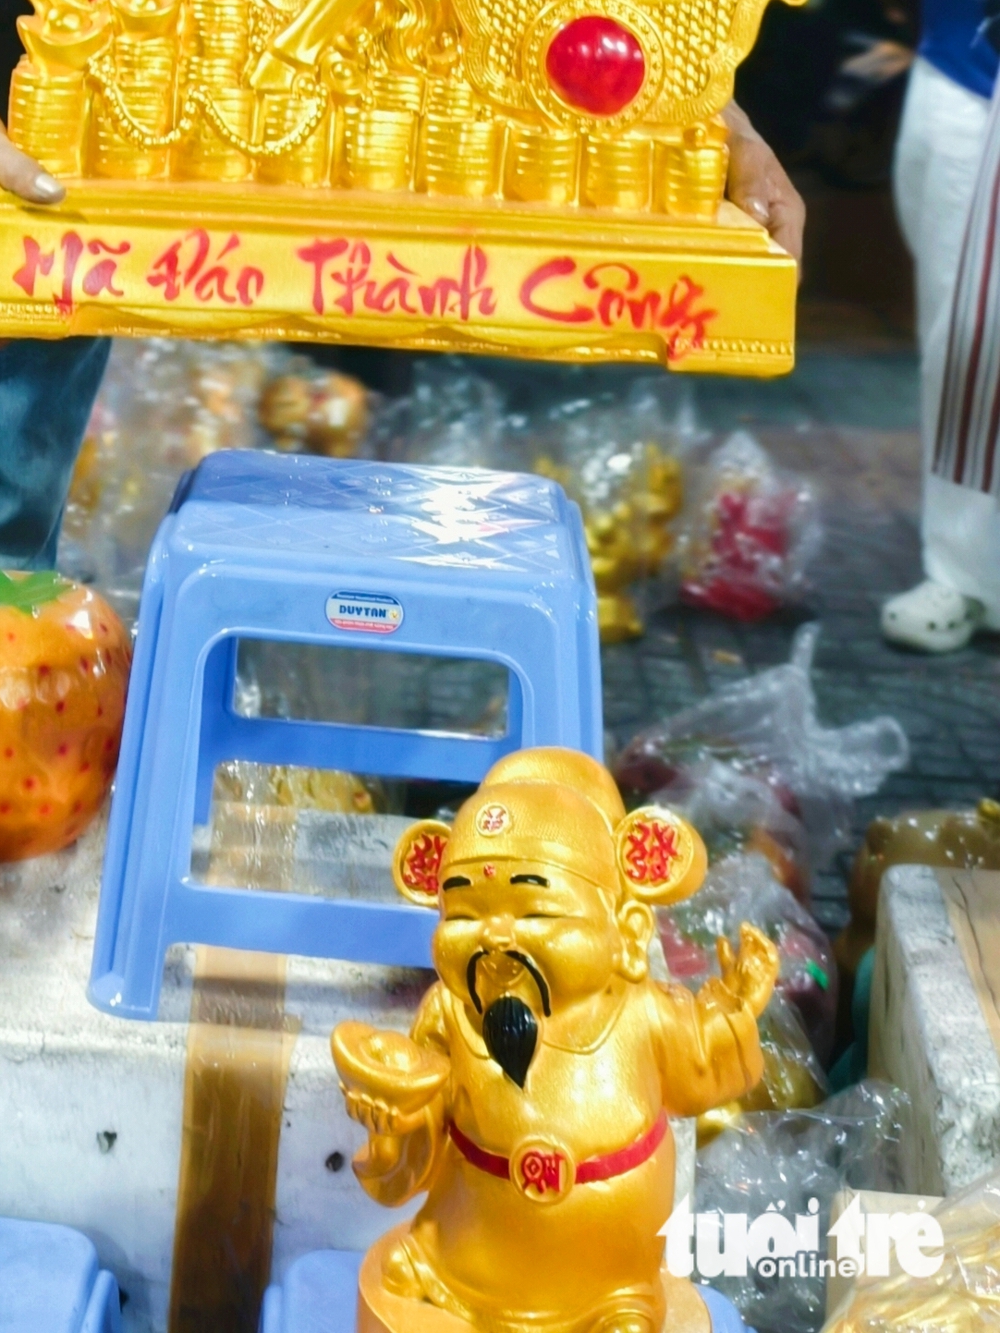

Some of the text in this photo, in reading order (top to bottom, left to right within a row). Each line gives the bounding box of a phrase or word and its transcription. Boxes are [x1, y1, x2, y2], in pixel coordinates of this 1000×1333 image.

[12, 227, 717, 361] Mã Đáo Thành Công
